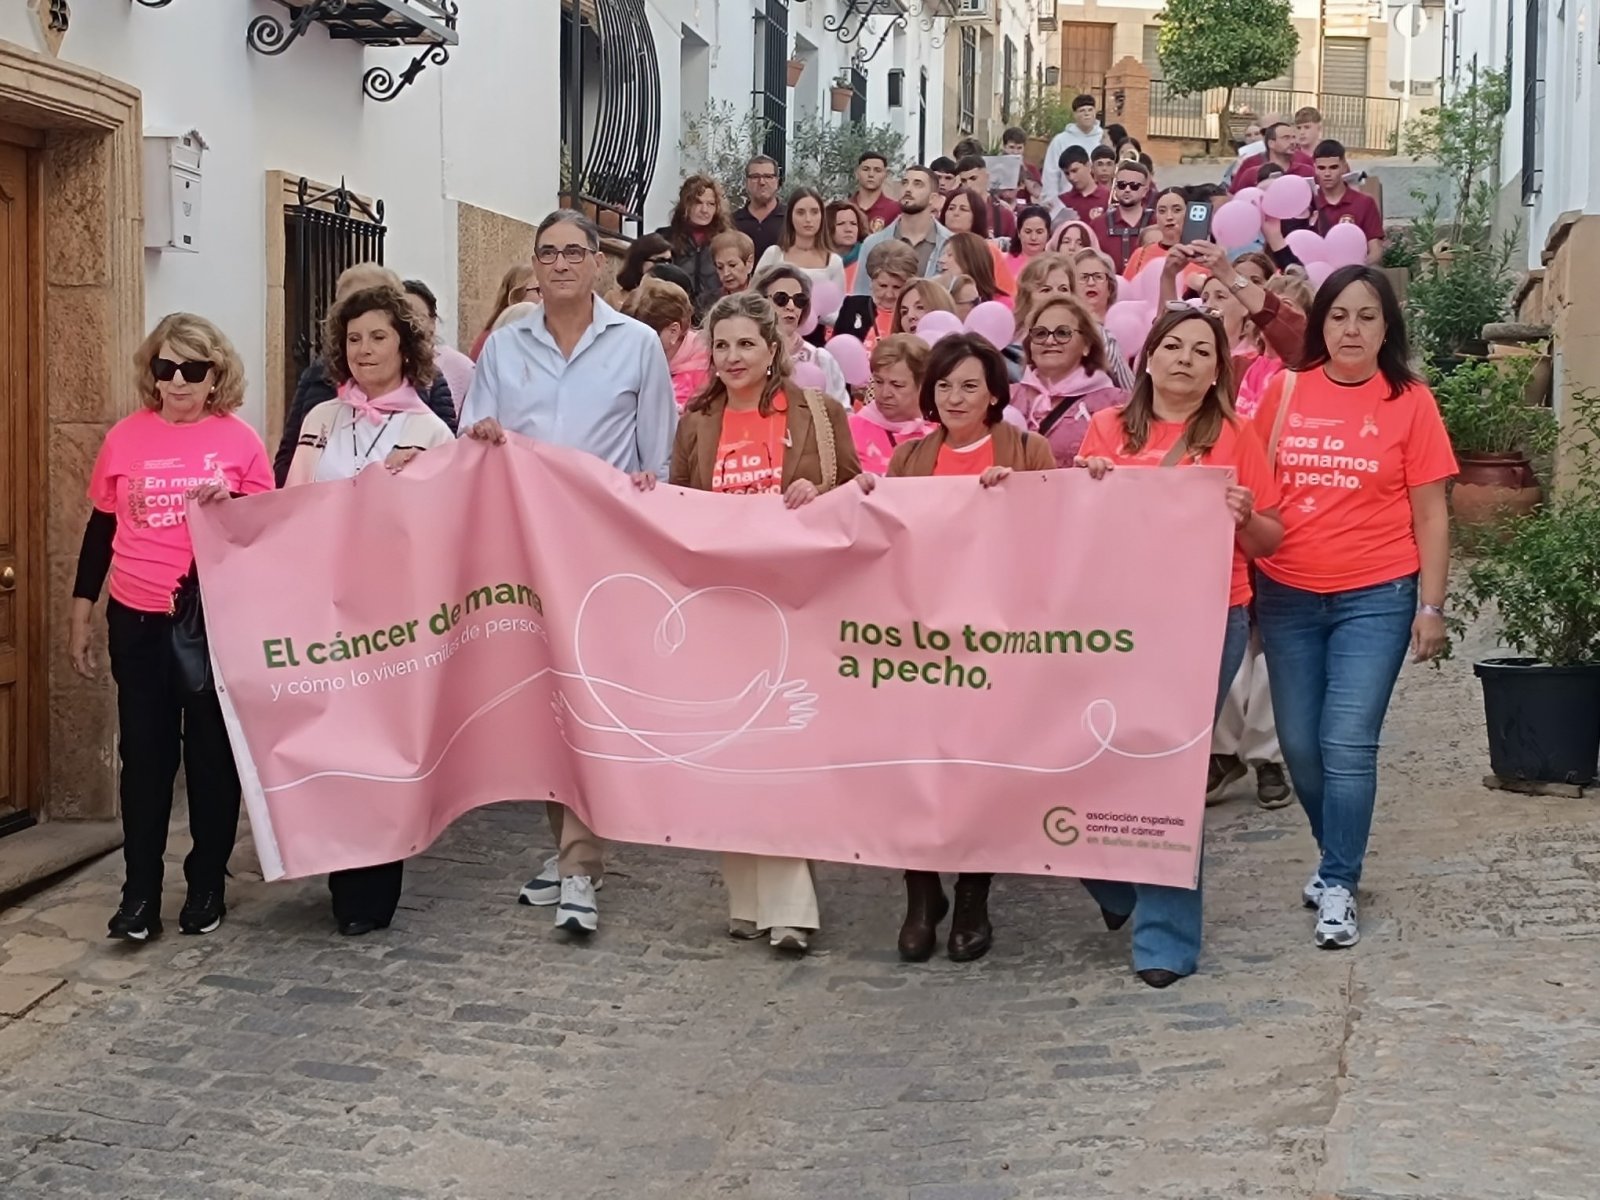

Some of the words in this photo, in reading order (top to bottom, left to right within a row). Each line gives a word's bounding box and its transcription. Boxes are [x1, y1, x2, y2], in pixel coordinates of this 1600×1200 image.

[1284, 436, 1318, 448] nos
[1323, 435, 1344, 450] lo
[742, 455, 761, 468] lo
[1281, 450, 1379, 472] tomamos
[145, 476, 166, 489] En
[1295, 470, 1362, 489] pecho.
[145, 492, 183, 507] con
[262, 636, 300, 668] El
[306, 619, 419, 665] cáncer
[429, 602, 461, 636] de
[464, 583, 543, 617] mama
[839, 619, 902, 647] nos
[912, 621, 950, 651] lo
[961, 624, 1134, 654] tomamos
[838, 654, 859, 678] a
[270, 683, 282, 702] y
[287, 676, 345, 695] cómo
[351, 669, 370, 687] lo
[373, 659, 419, 681] viven
[1086, 811, 1138, 824] asociación
[1140, 814, 1185, 826] española
[1086, 822, 1118, 834] contra
[1120, 825, 1129, 834] el
